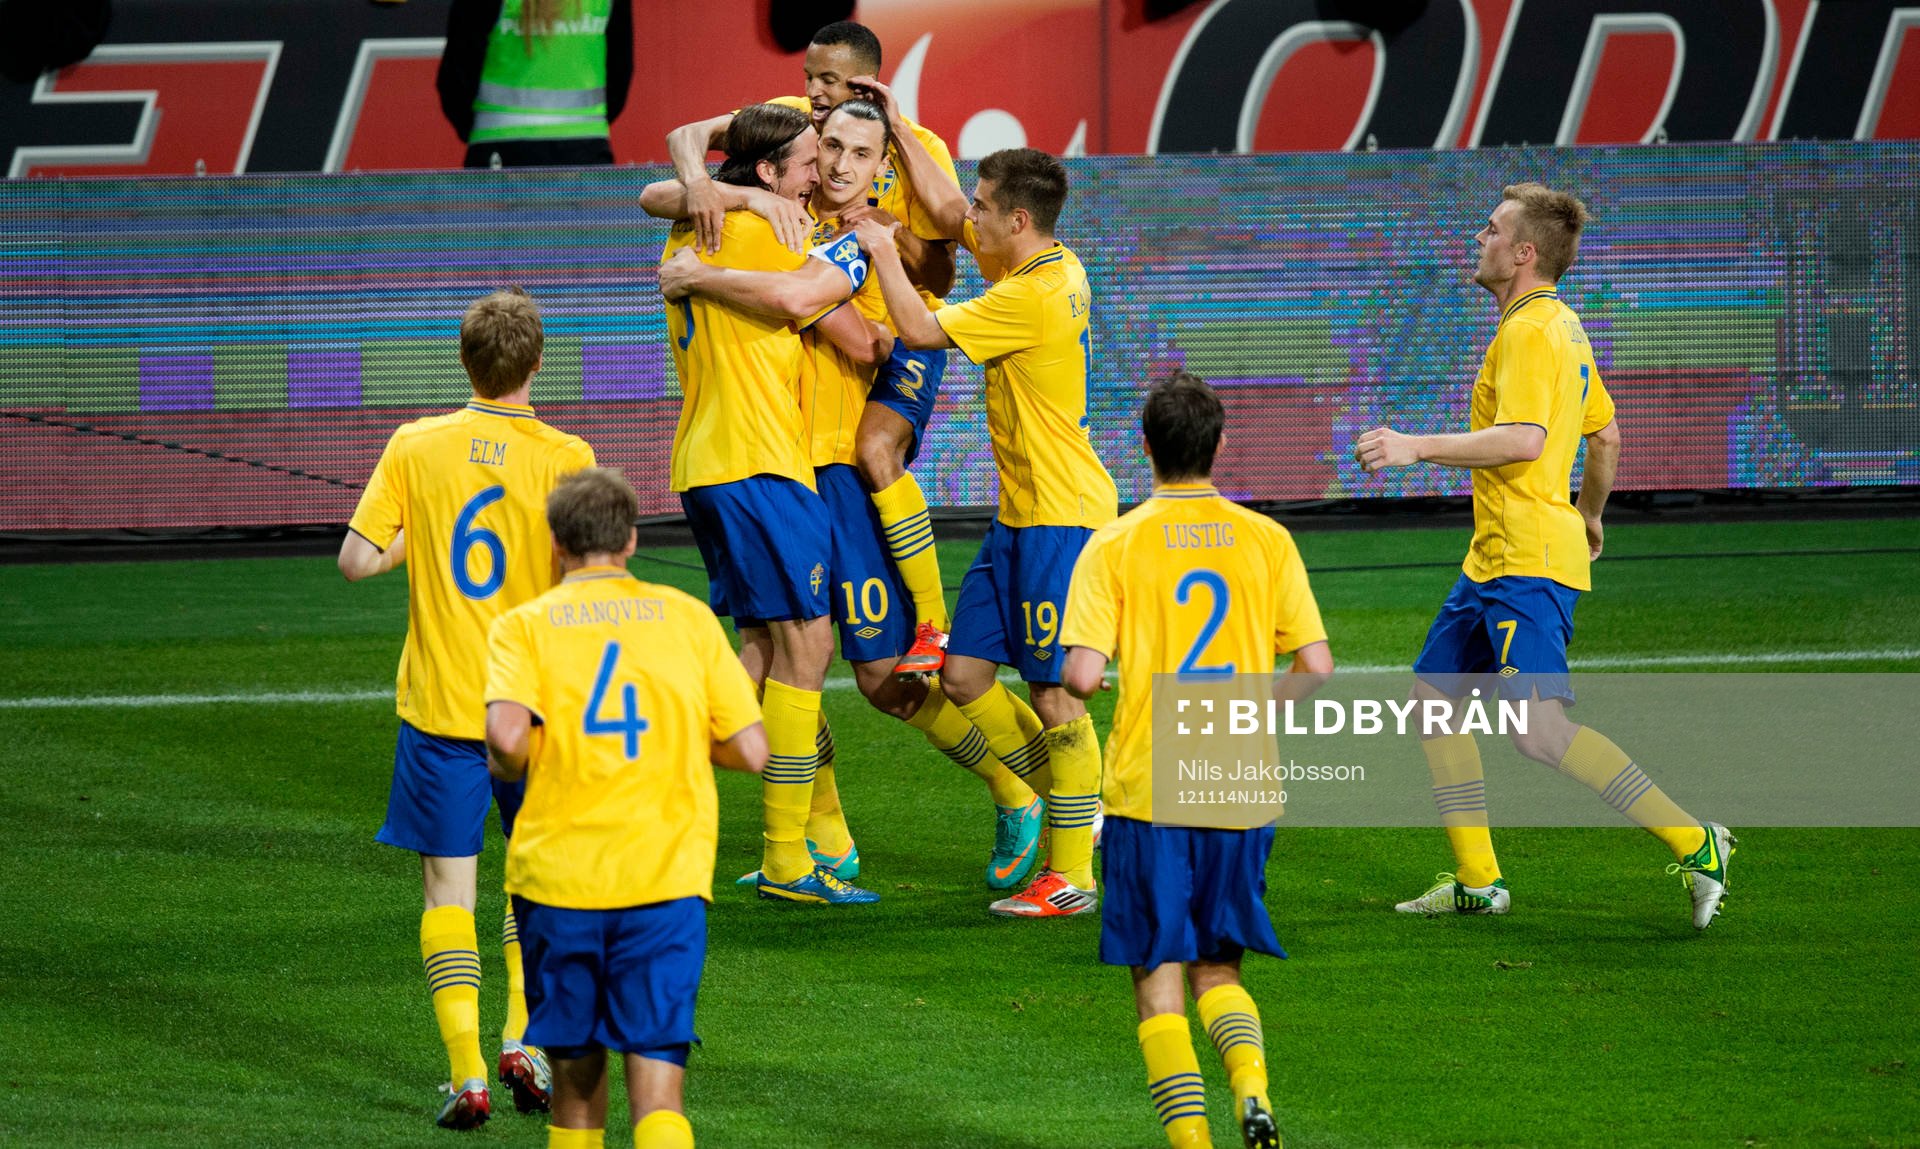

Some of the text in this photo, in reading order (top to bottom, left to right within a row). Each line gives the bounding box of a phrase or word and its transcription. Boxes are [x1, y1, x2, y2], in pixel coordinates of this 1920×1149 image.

[898, 359, 926, 390] 5
[468, 438, 507, 466] ELM
[450, 485, 507, 600] 6
[1162, 522, 1235, 550] LUSTIG
[549, 599, 667, 628] GRANQVIST
[841, 576, 889, 626] 10
[1021, 600, 1059, 649] 19
[1174, 568, 1236, 684] 2
[1496, 619, 1518, 665] 7
[583, 641, 649, 760] 4
